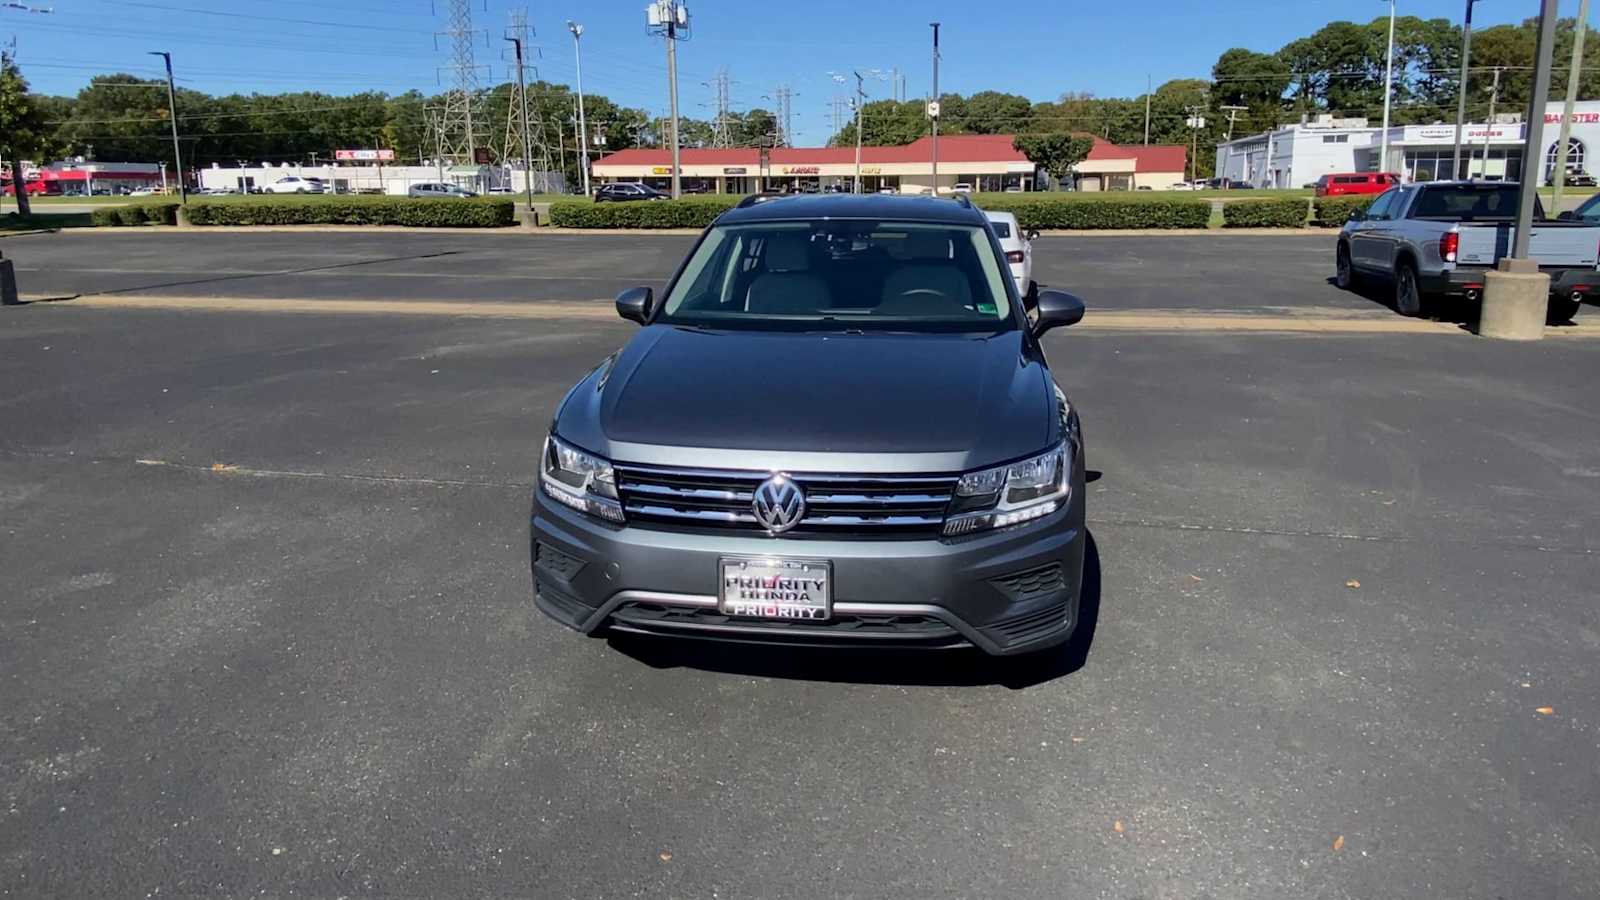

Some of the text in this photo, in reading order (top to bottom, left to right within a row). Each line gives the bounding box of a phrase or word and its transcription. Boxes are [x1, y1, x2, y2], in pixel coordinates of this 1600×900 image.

[1544, 114, 1600, 123] BASTER
[726, 575, 824, 591] PRIORITY
[741, 590, 811, 601] HONDA
[734, 606, 817, 618] PRIORITY
